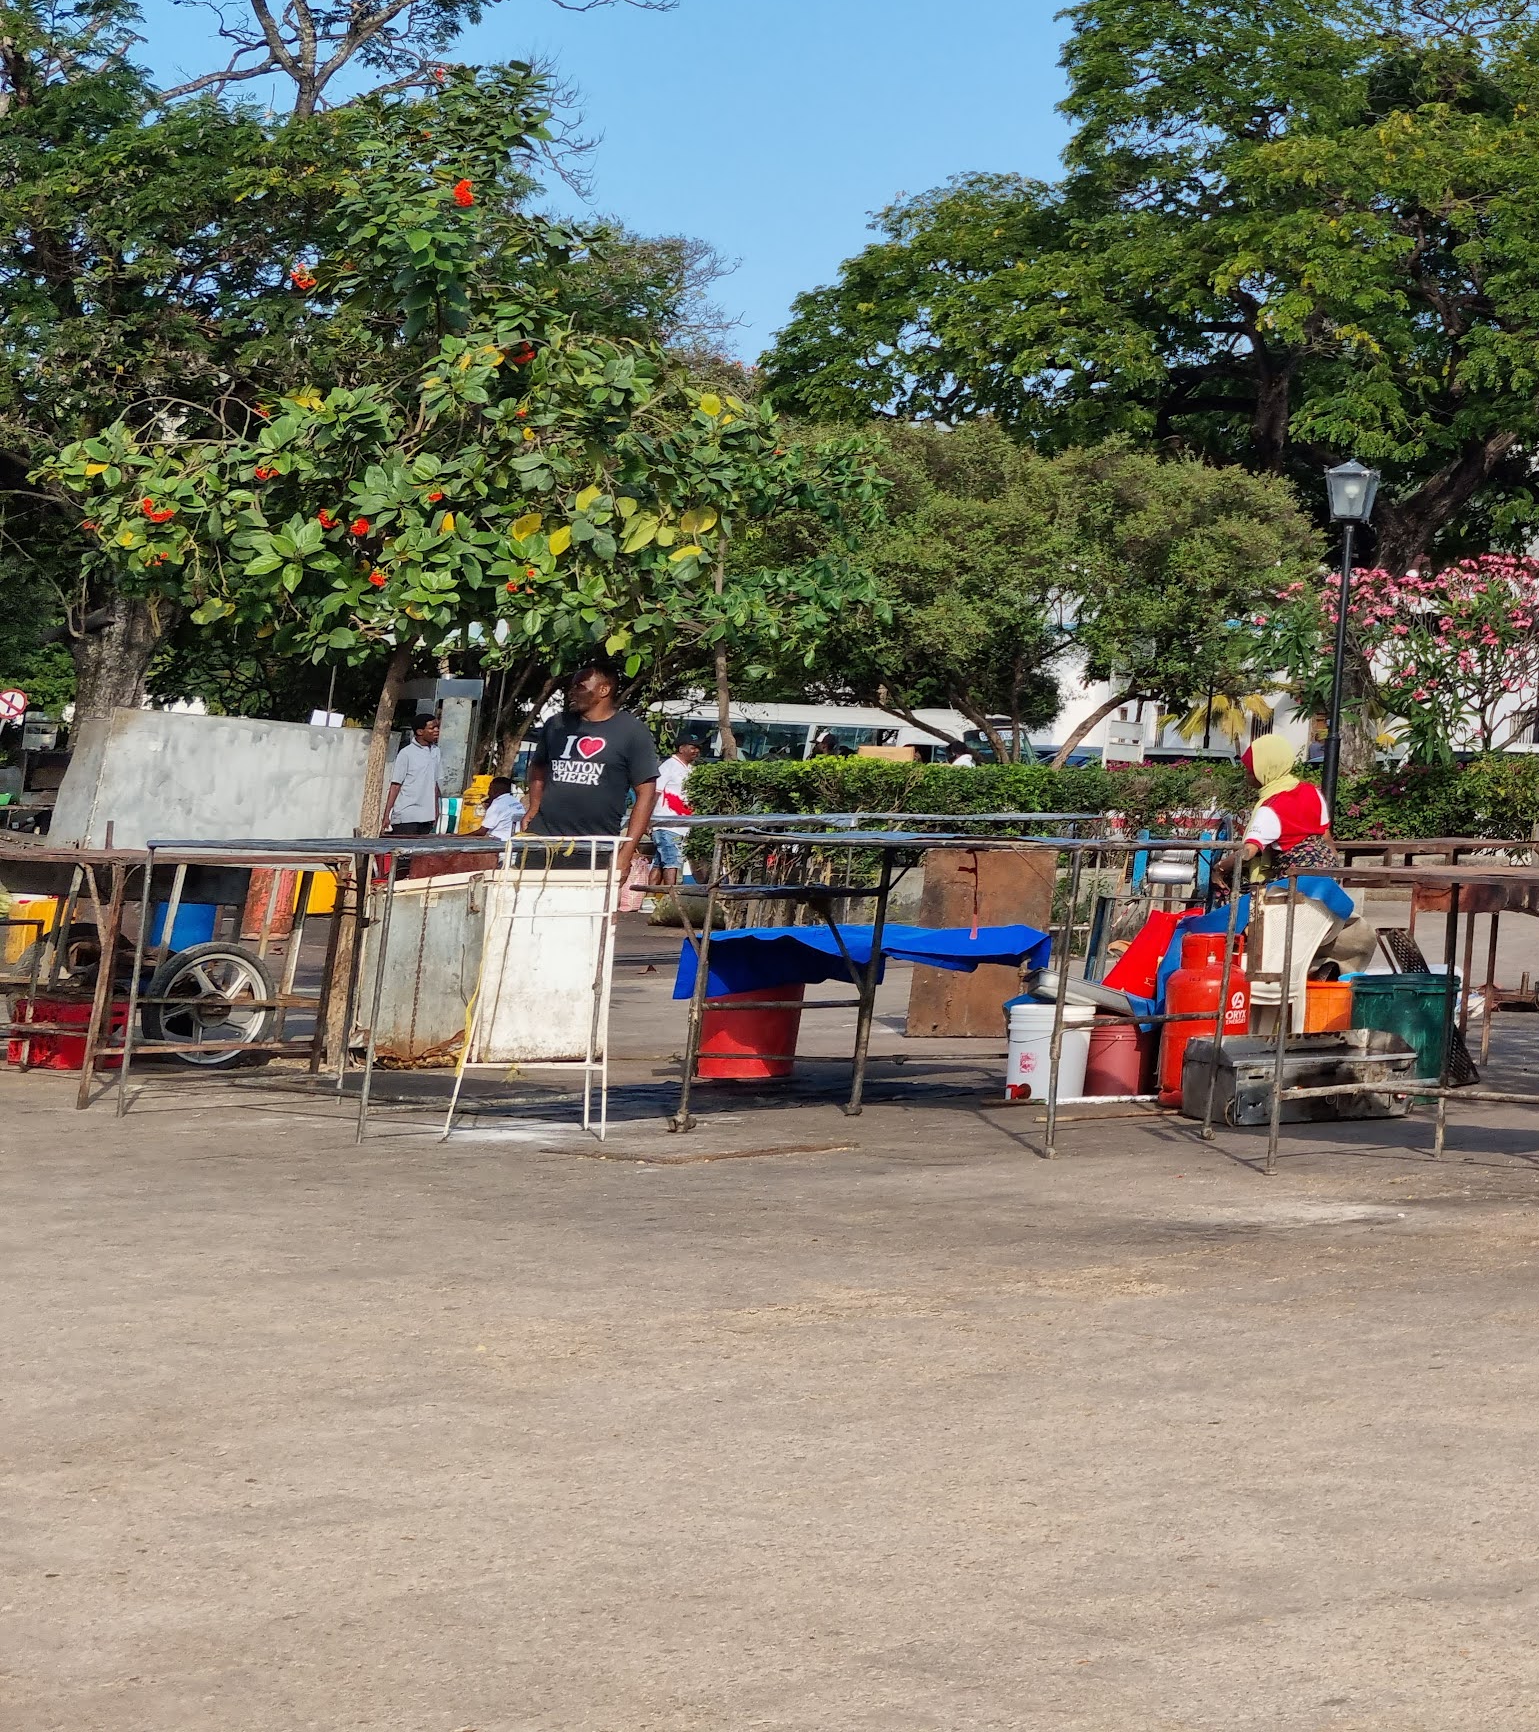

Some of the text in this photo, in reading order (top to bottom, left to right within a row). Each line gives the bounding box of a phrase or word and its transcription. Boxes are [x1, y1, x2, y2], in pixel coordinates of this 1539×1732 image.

[560, 735, 578, 759] I
[551, 759, 606, 775] BENTON
[552, 770, 600, 786] CHEER
[1225, 1009, 1247, 1019] ORYX
